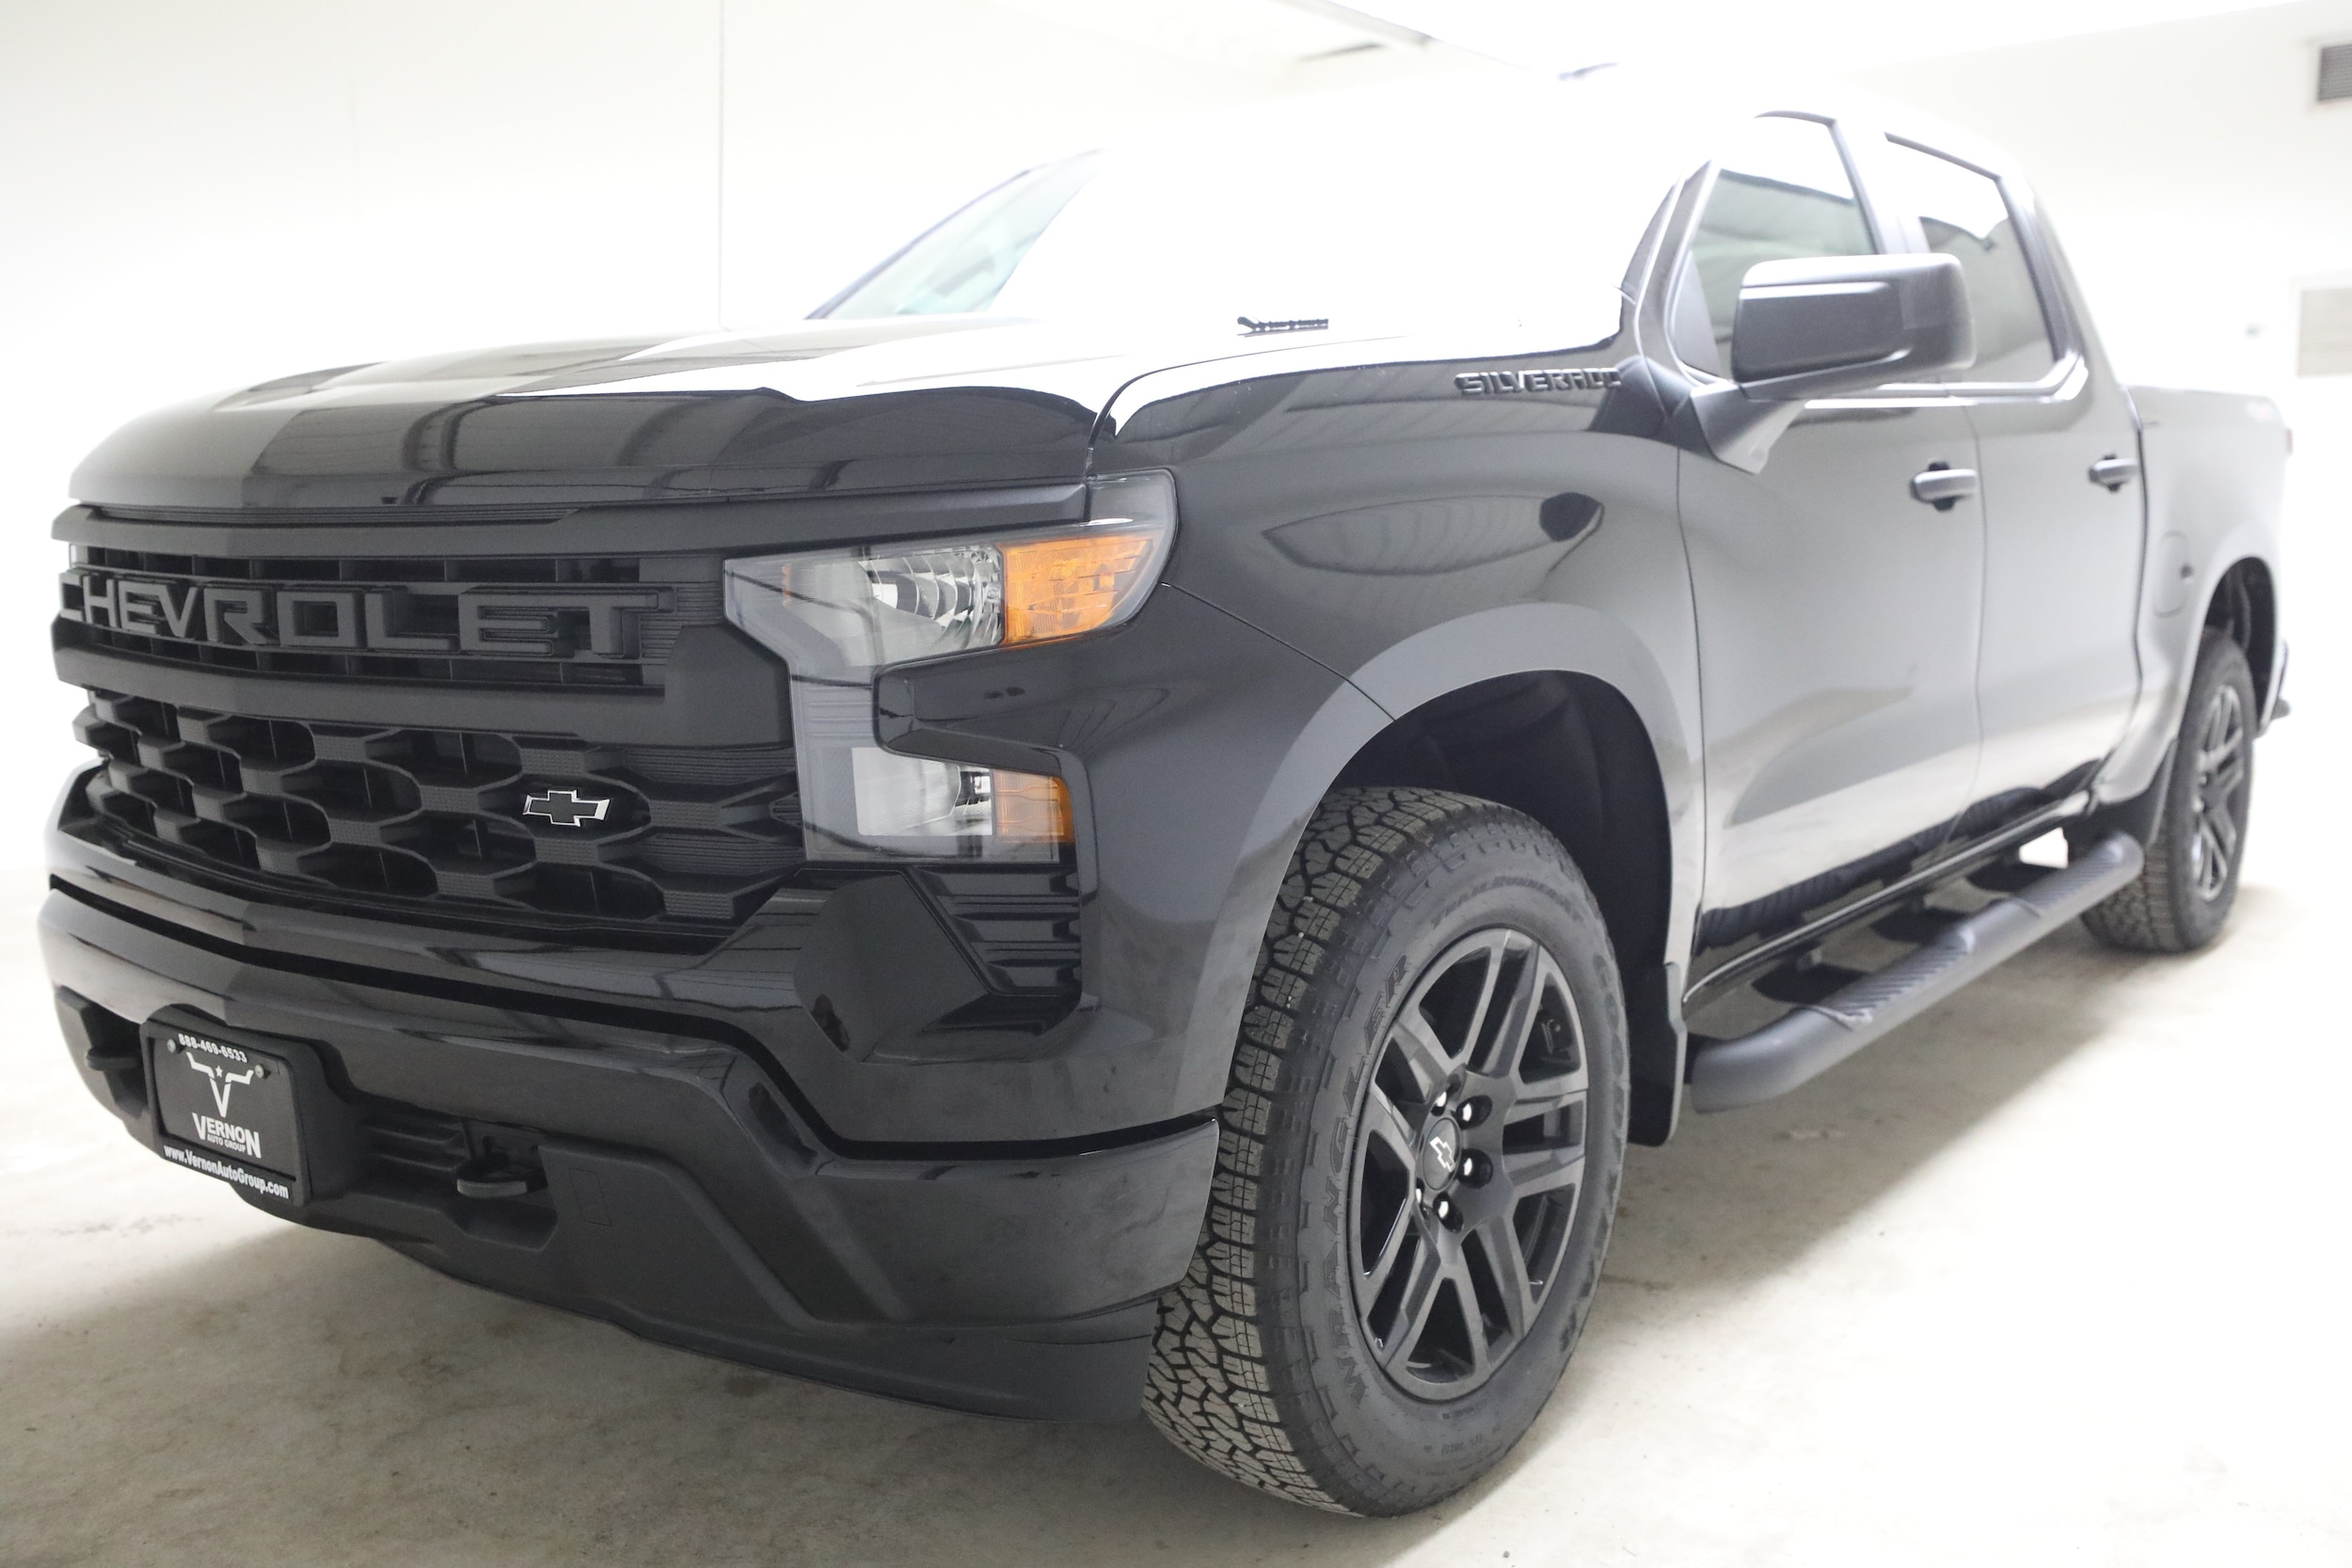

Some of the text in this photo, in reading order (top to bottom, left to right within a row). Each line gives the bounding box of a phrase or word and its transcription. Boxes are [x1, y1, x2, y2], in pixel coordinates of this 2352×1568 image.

[59, 569, 670, 657] CHEVROLET
[178, 1034, 247, 1063] 888-469-6533
[192, 1112, 262, 1159] VERNON
[207, 1133, 246, 1153] AUTO GROUP
[164, 1145, 289, 1199] www.VernonAutoGroup.com
[1324, 954, 1407, 1407] WRANGLER
